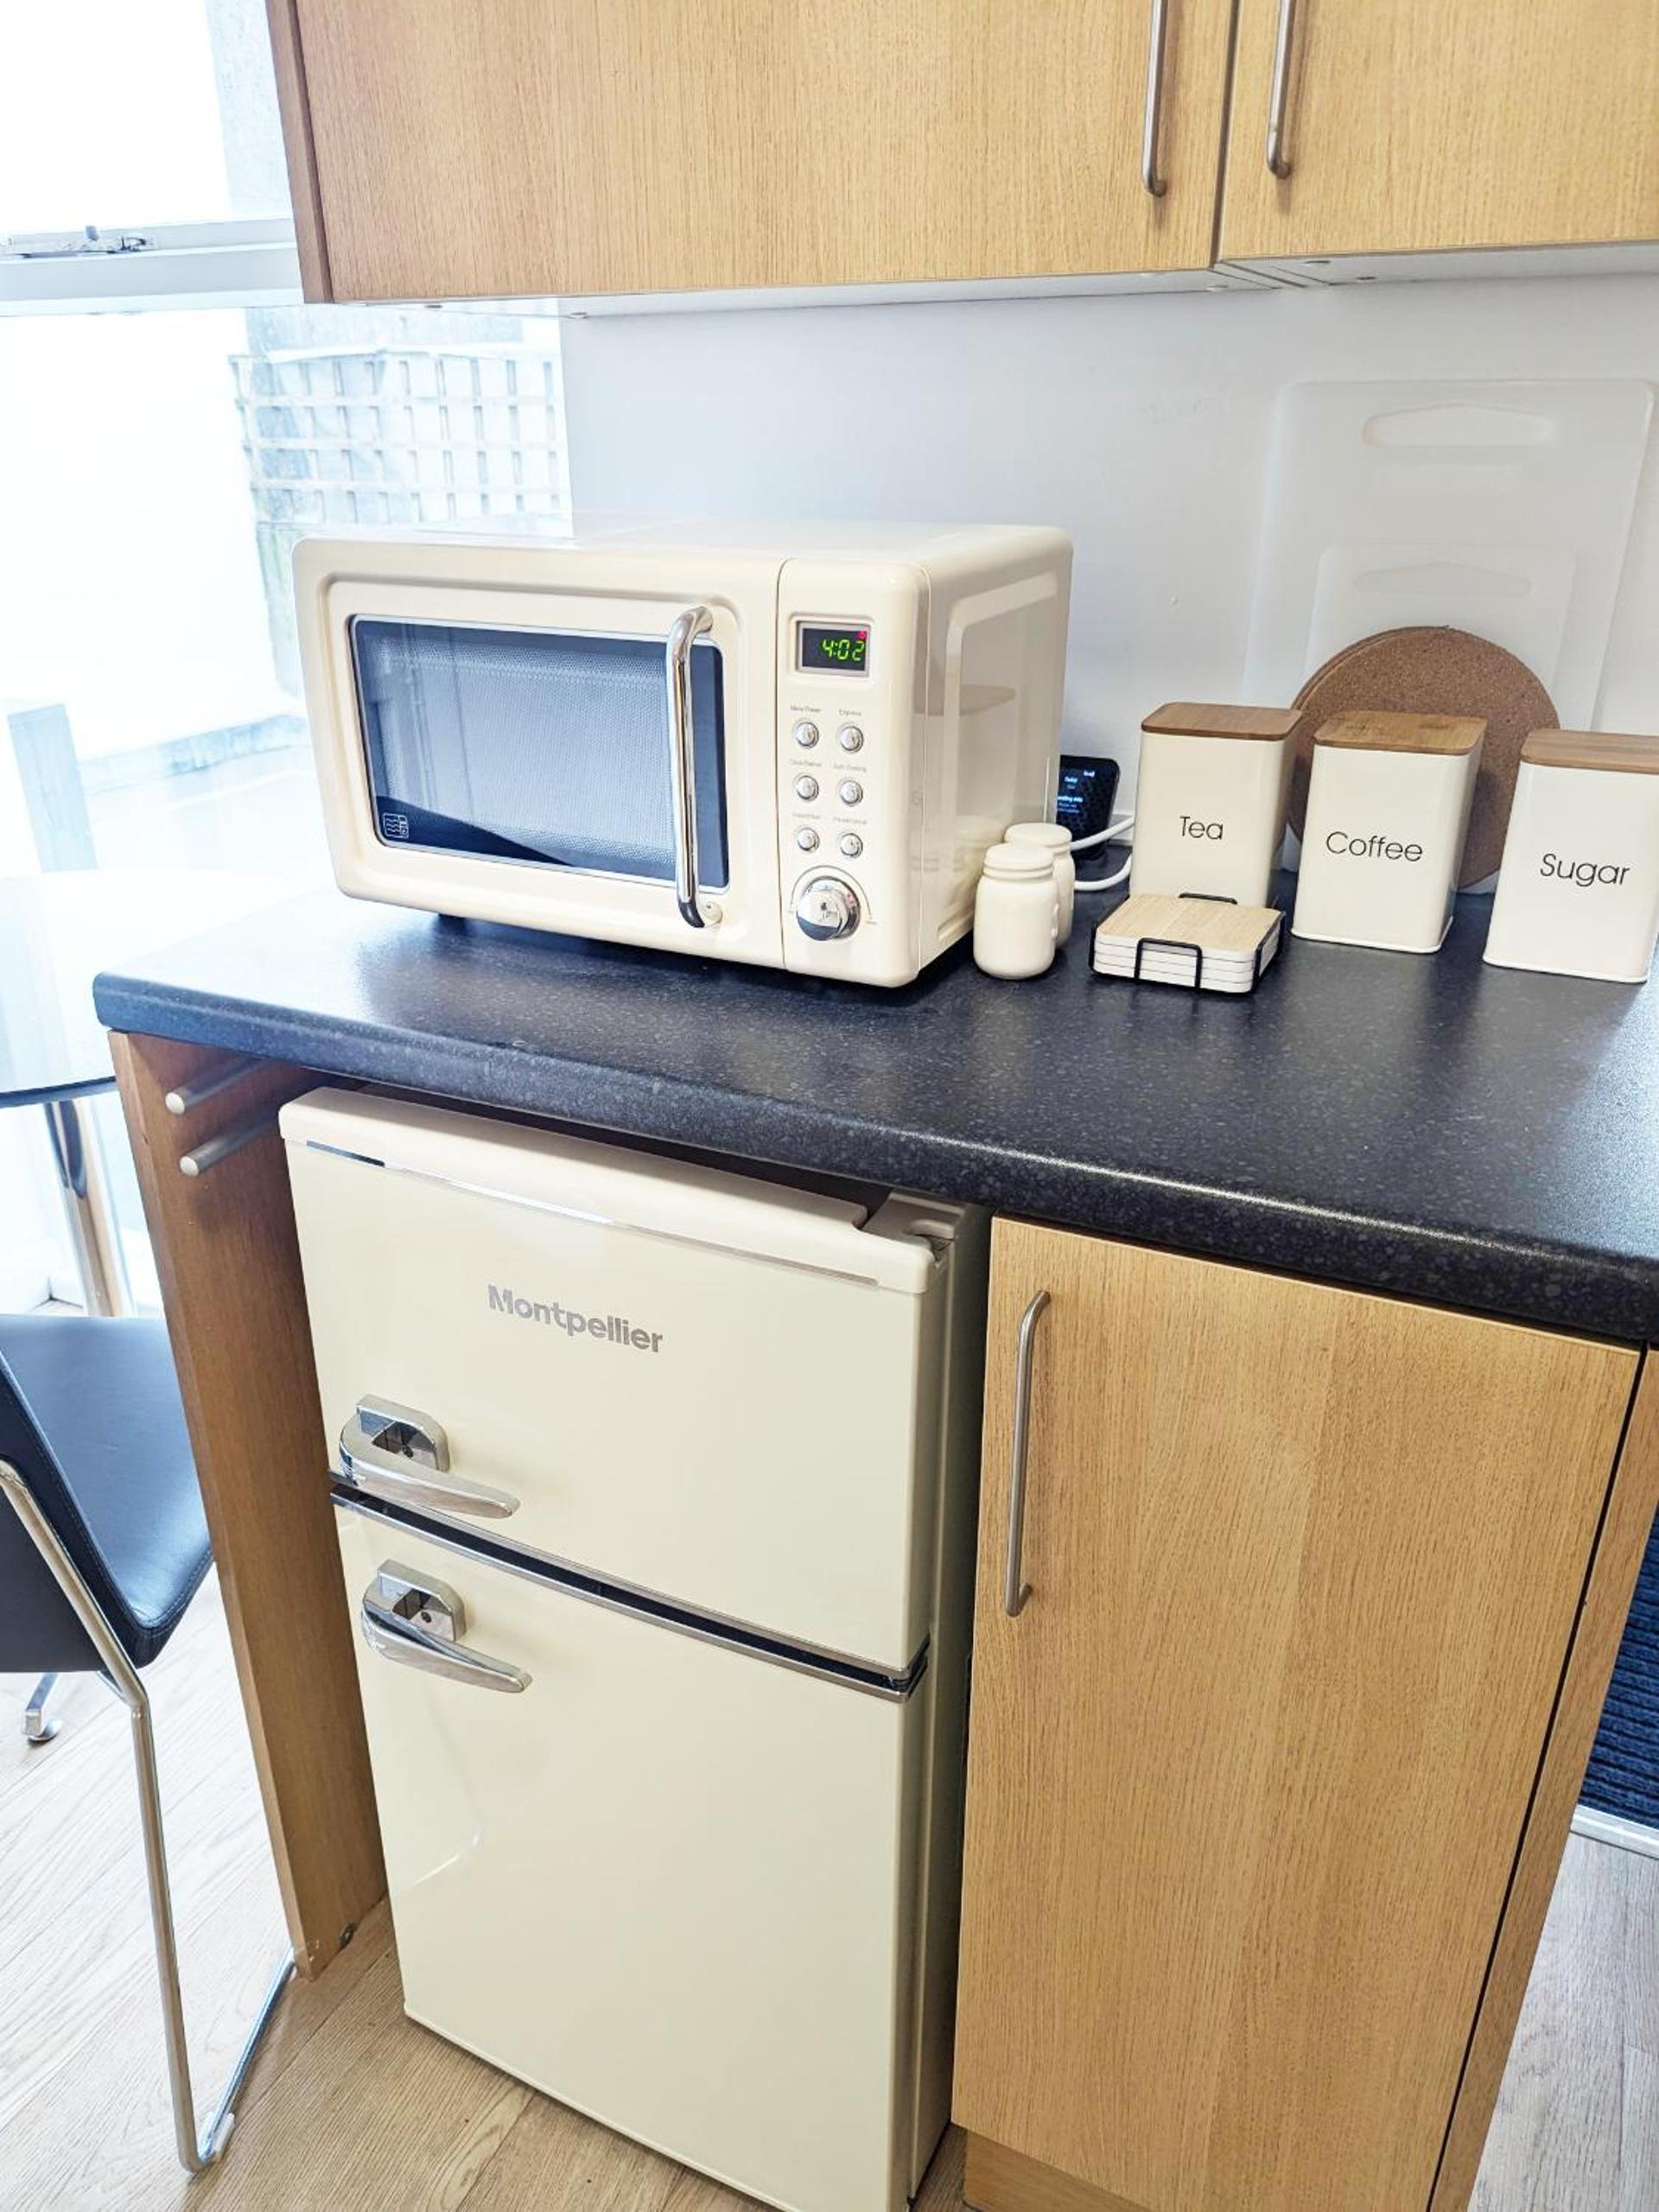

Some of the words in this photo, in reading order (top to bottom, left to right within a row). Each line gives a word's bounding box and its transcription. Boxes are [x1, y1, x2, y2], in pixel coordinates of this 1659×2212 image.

[822, 638, 865, 662] 4:02
[1179, 816, 1224, 841] Tea
[1325, 830, 1424, 862] Coffee
[1540, 853, 1631, 887] Sugar
[487, 1283, 664, 1354] Montpellier
